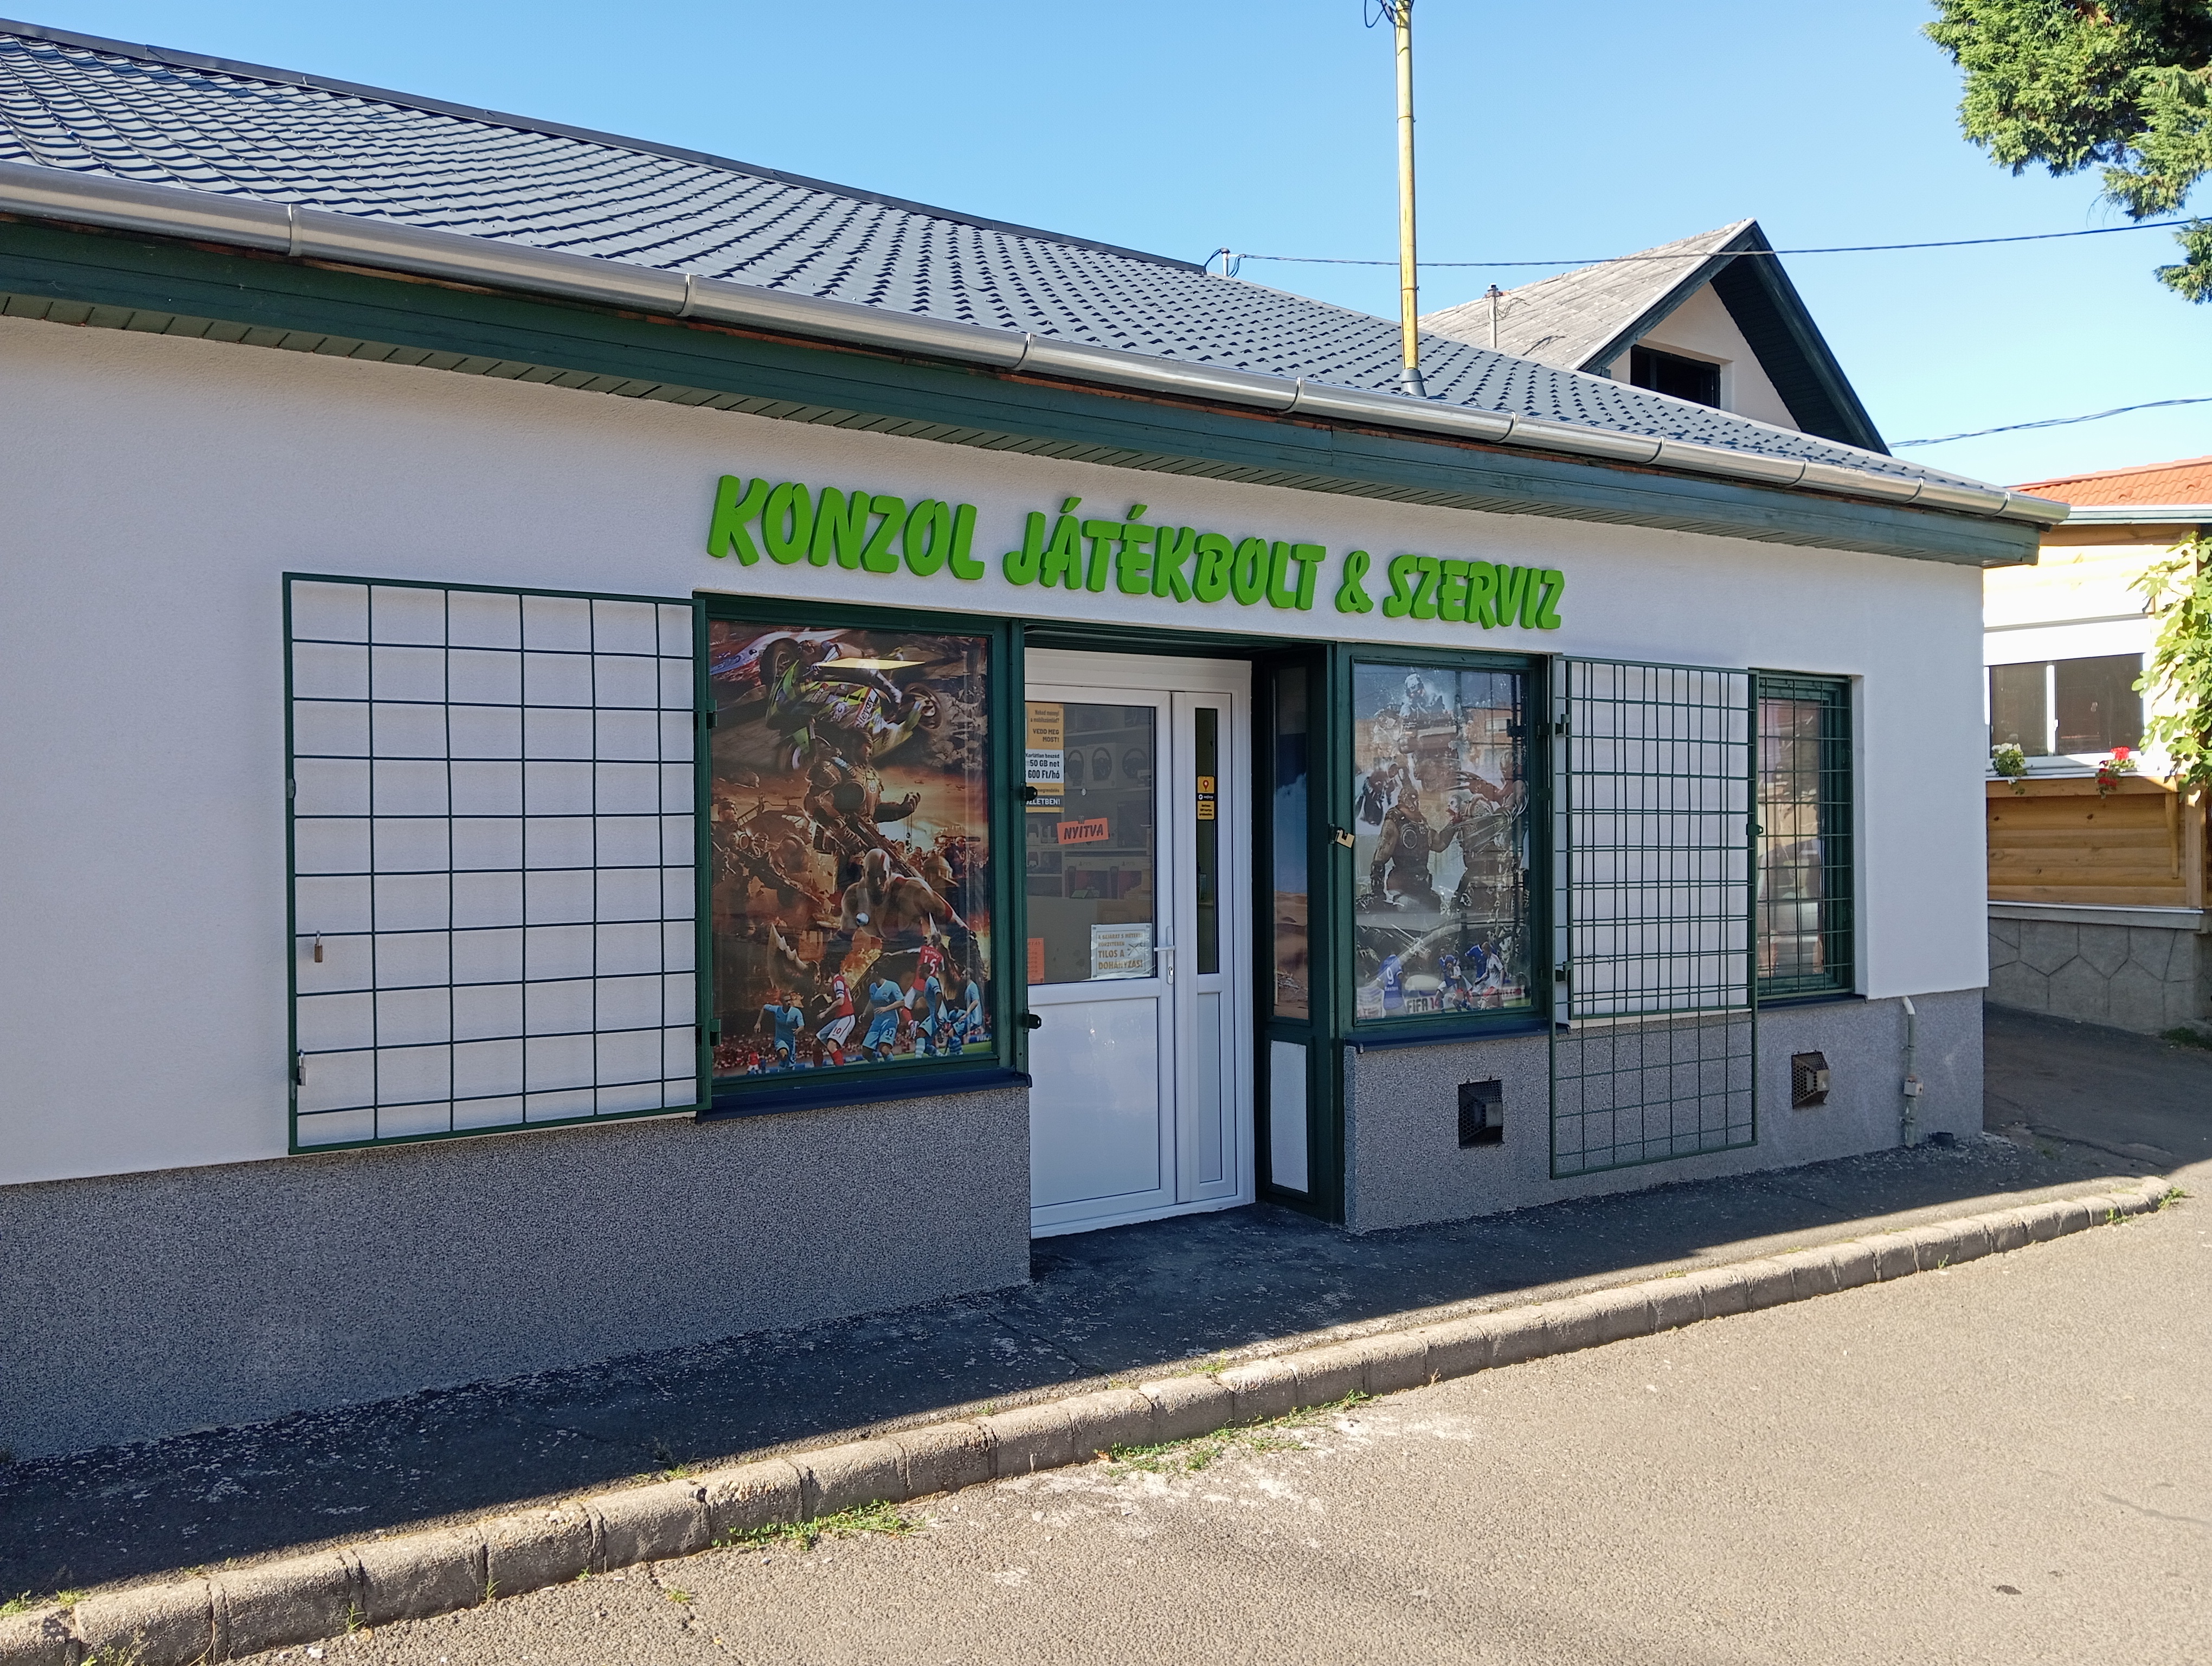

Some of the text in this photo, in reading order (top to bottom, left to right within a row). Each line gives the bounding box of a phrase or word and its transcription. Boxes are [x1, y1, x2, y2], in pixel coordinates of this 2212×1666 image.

[707, 475, 1565, 630] KONZOL JÁTÉKBOLT & SZERVIZ
[1028, 770, 1060, 779] 600 Ft/hó
[1064, 824, 1103, 840] NYITVA
[1098, 949, 1124, 958] TILOS A
[1098, 958, 1143, 970] DOHÁNYZÁS!
[1386, 966, 1394, 985] 9
[1407, 998, 1428, 1013] FIFA
[886, 1028, 893, 1037] 32
